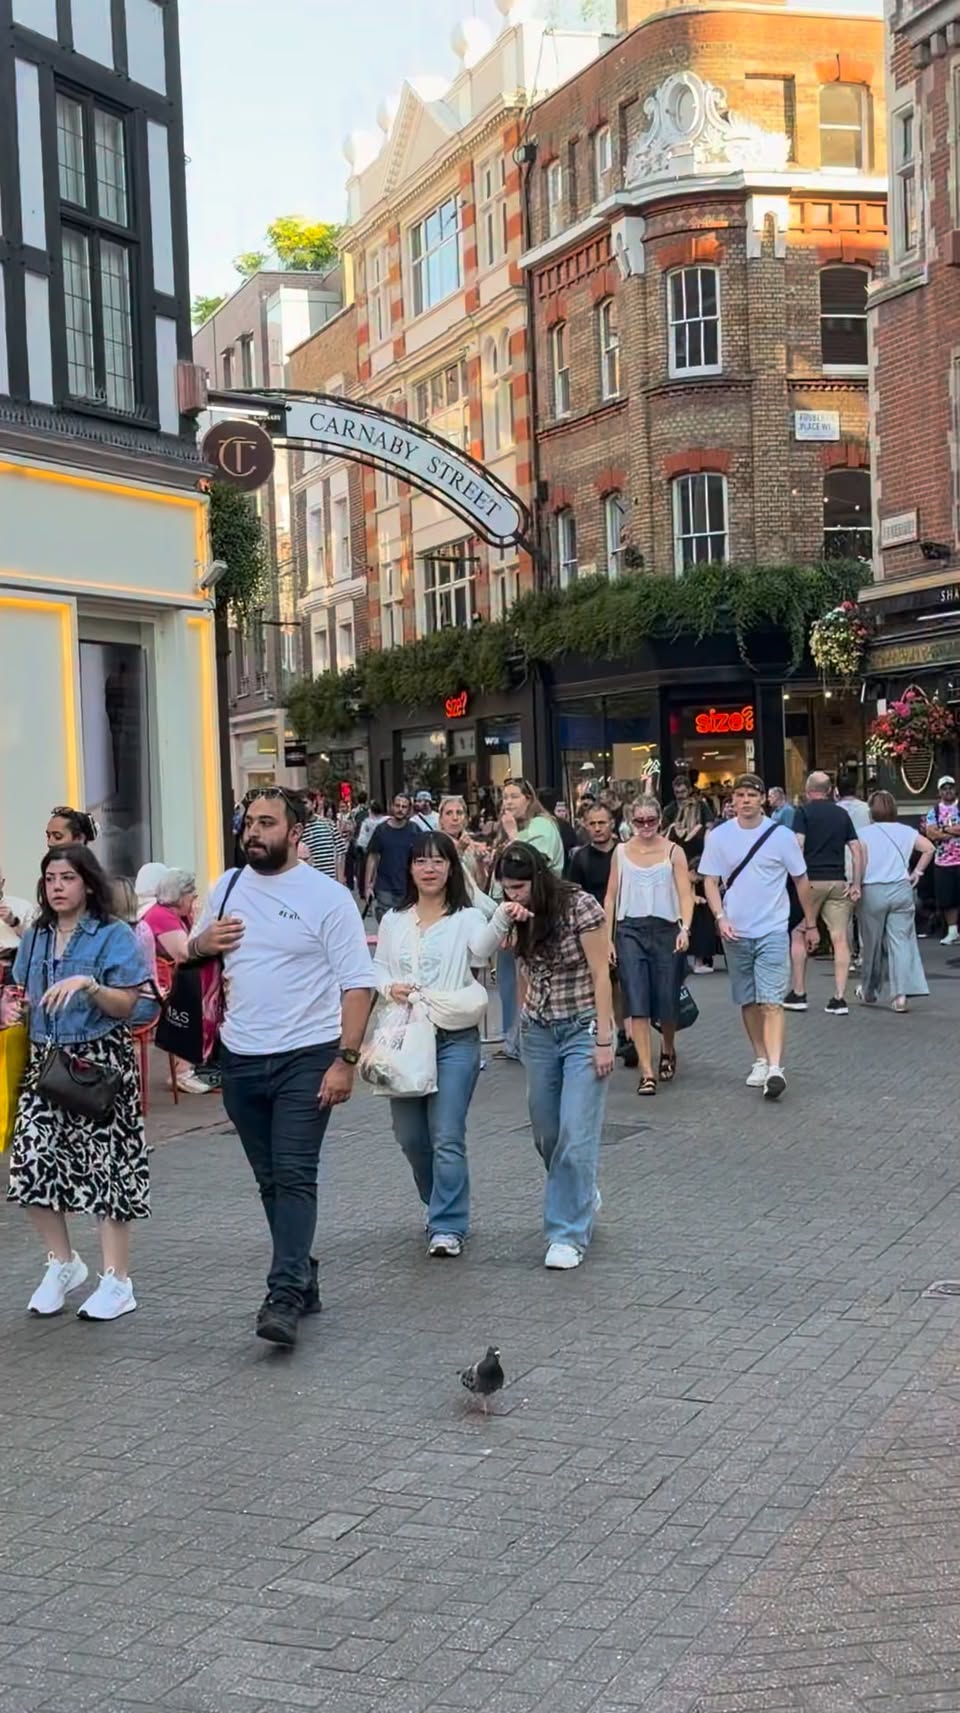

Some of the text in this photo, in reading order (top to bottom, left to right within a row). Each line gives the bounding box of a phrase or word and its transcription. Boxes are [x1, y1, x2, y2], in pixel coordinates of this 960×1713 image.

[310, 413, 502, 518] CARNABY STREET
[445, 691, 468, 717] size?
[695, 706, 755, 733] size?
